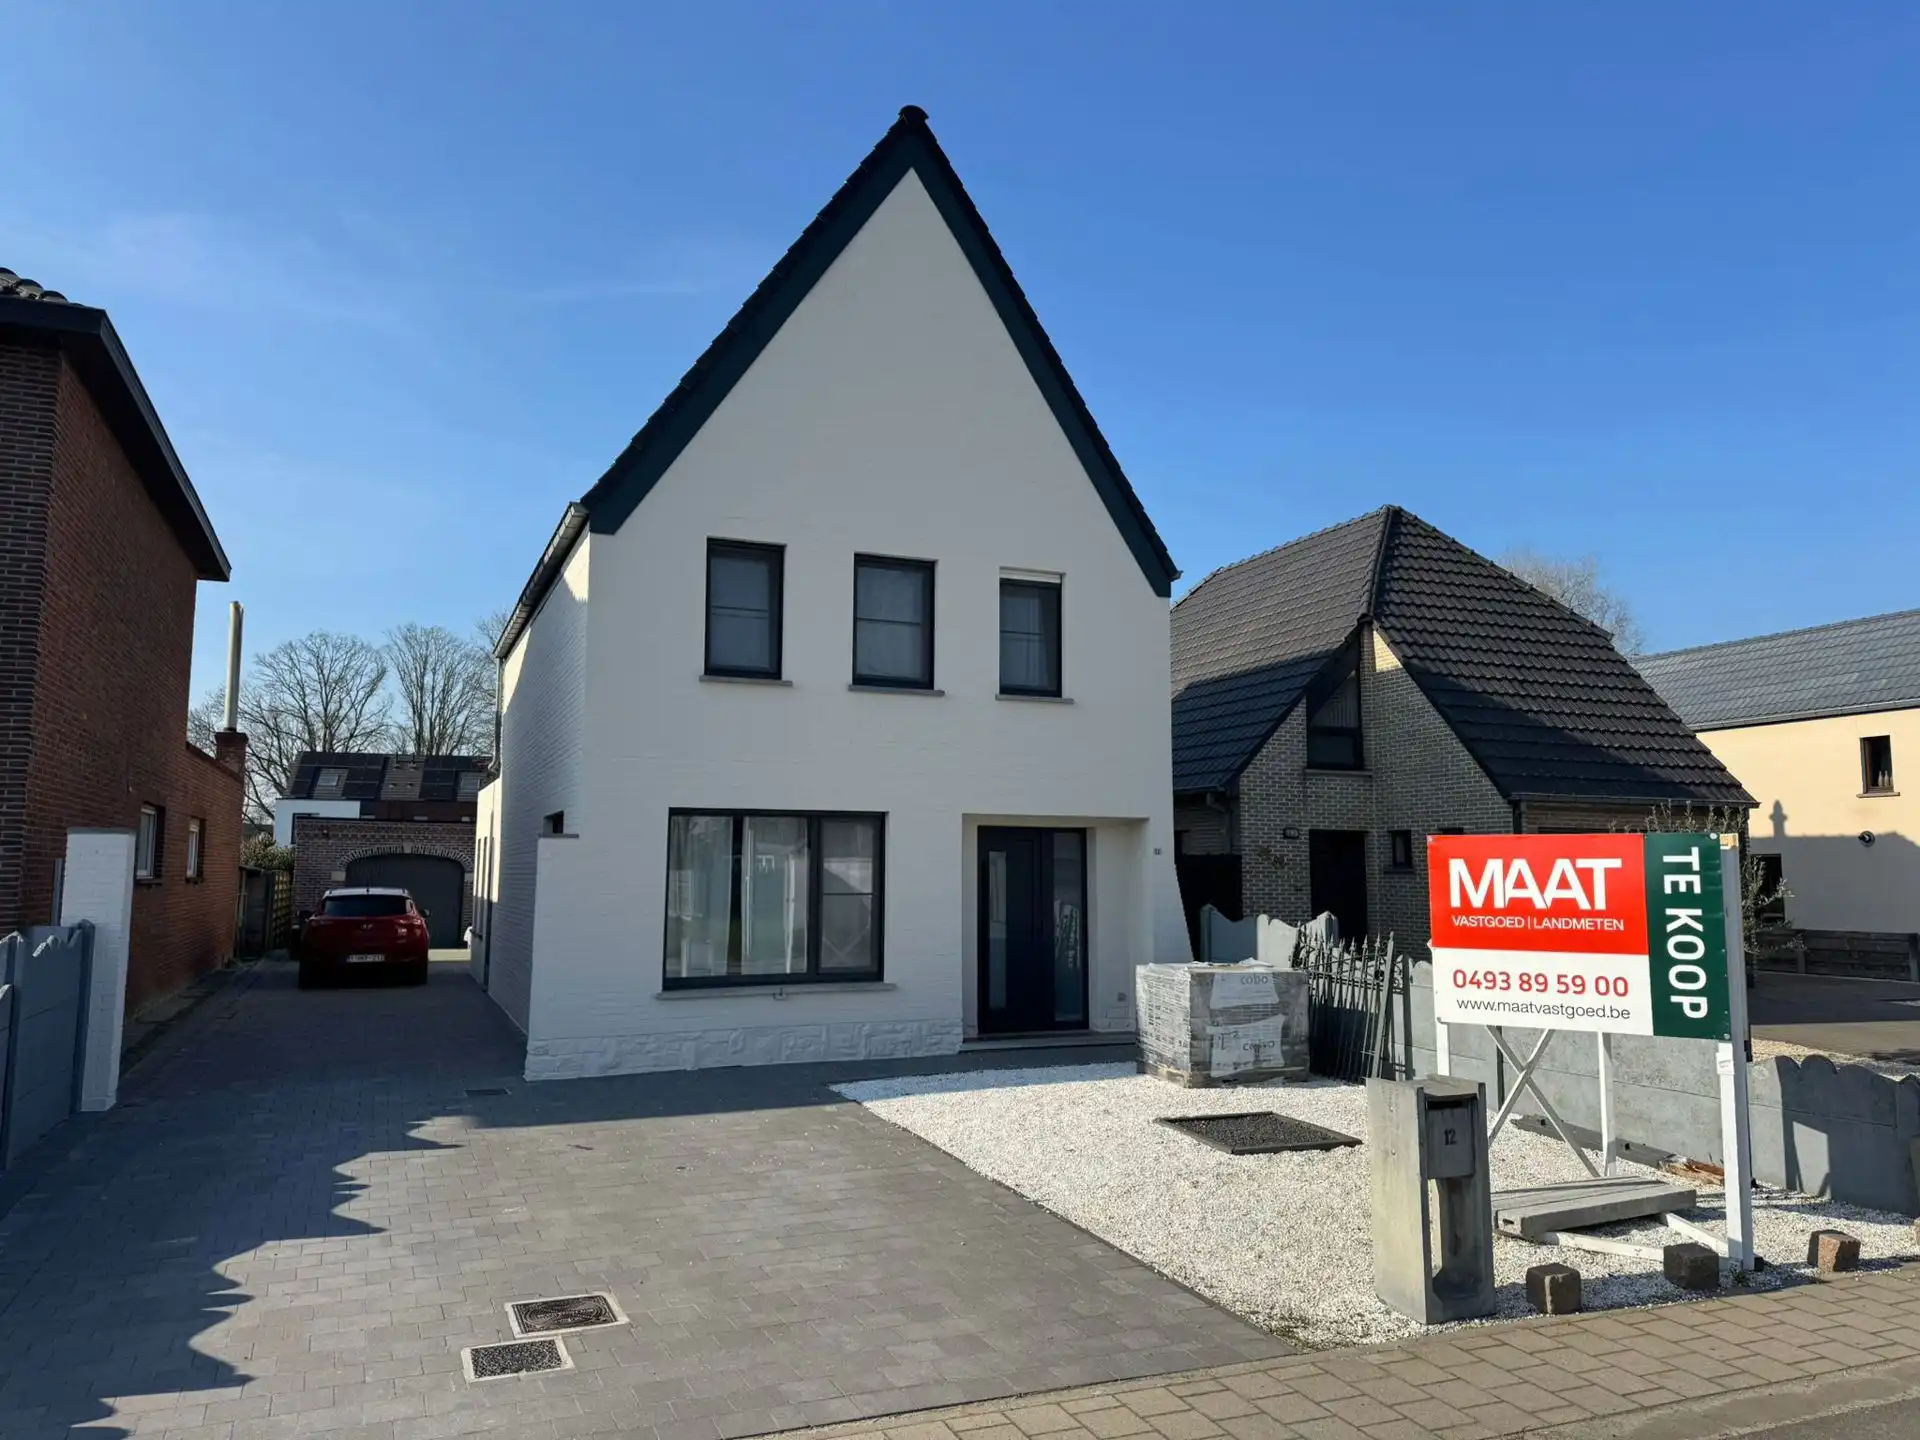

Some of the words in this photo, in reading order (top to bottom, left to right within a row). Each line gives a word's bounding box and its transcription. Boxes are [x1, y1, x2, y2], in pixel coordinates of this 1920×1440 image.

[1449, 858, 1622, 910] MAAT
[1663, 846, 1702, 894] TE
[1452, 915, 1525, 929] VASTGOED
[1533, 917, 1624, 931] LANDMETEN
[1665, 908, 1708, 1019] KOOP
[1453, 969, 1511, 991] 0493
[1518, 972, 1549, 993] 89
[1556, 974, 1586, 995] 59
[1594, 976, 1629, 997] 00
[1456, 999, 1631, 1019] www.maatvastgoed.be
[1444, 1128, 1457, 1146] 12
